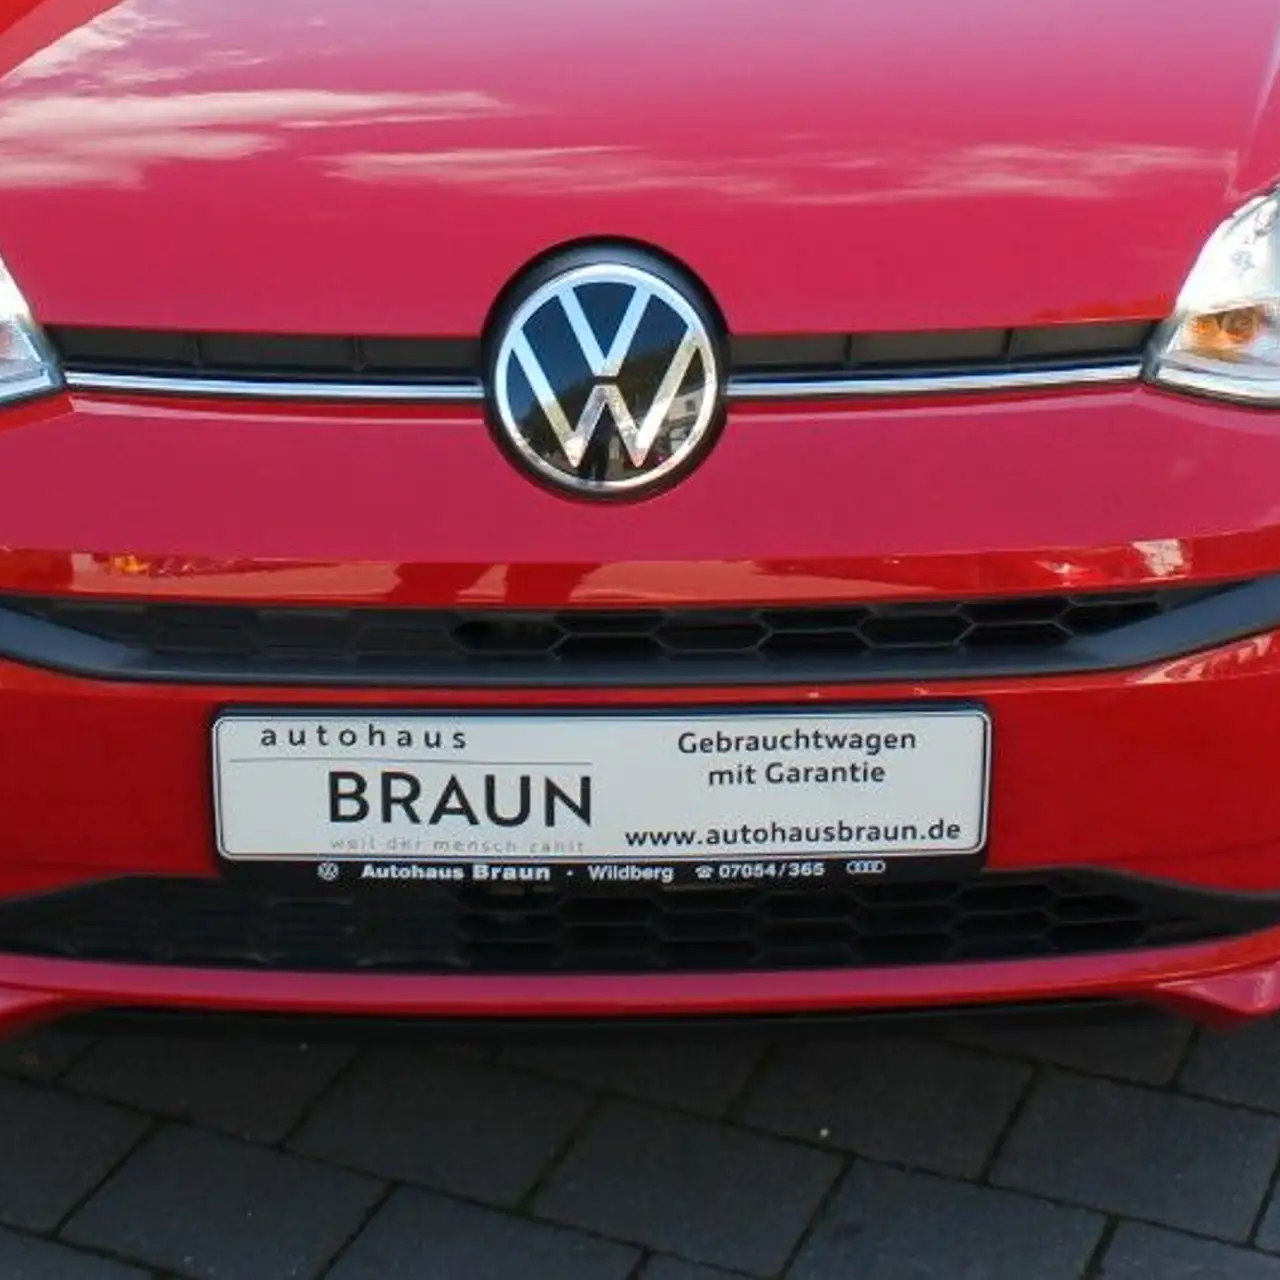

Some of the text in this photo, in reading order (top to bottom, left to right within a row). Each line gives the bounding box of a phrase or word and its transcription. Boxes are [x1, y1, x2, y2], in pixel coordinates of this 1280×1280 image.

[261, 724, 467, 749] autohaus
[677, 728, 917, 756] Gebrauchtwagen
[708, 761, 887, 786] mit Garantie
[328, 770, 592, 828] BRAUN
[624, 818, 962, 847] www.autohausbraun.de
[433, 838, 518, 853] mensch
[361, 863, 464, 880] Autohaus
[472, 863, 551, 881] Braun
[586, 864, 675, 884] Wildberg
